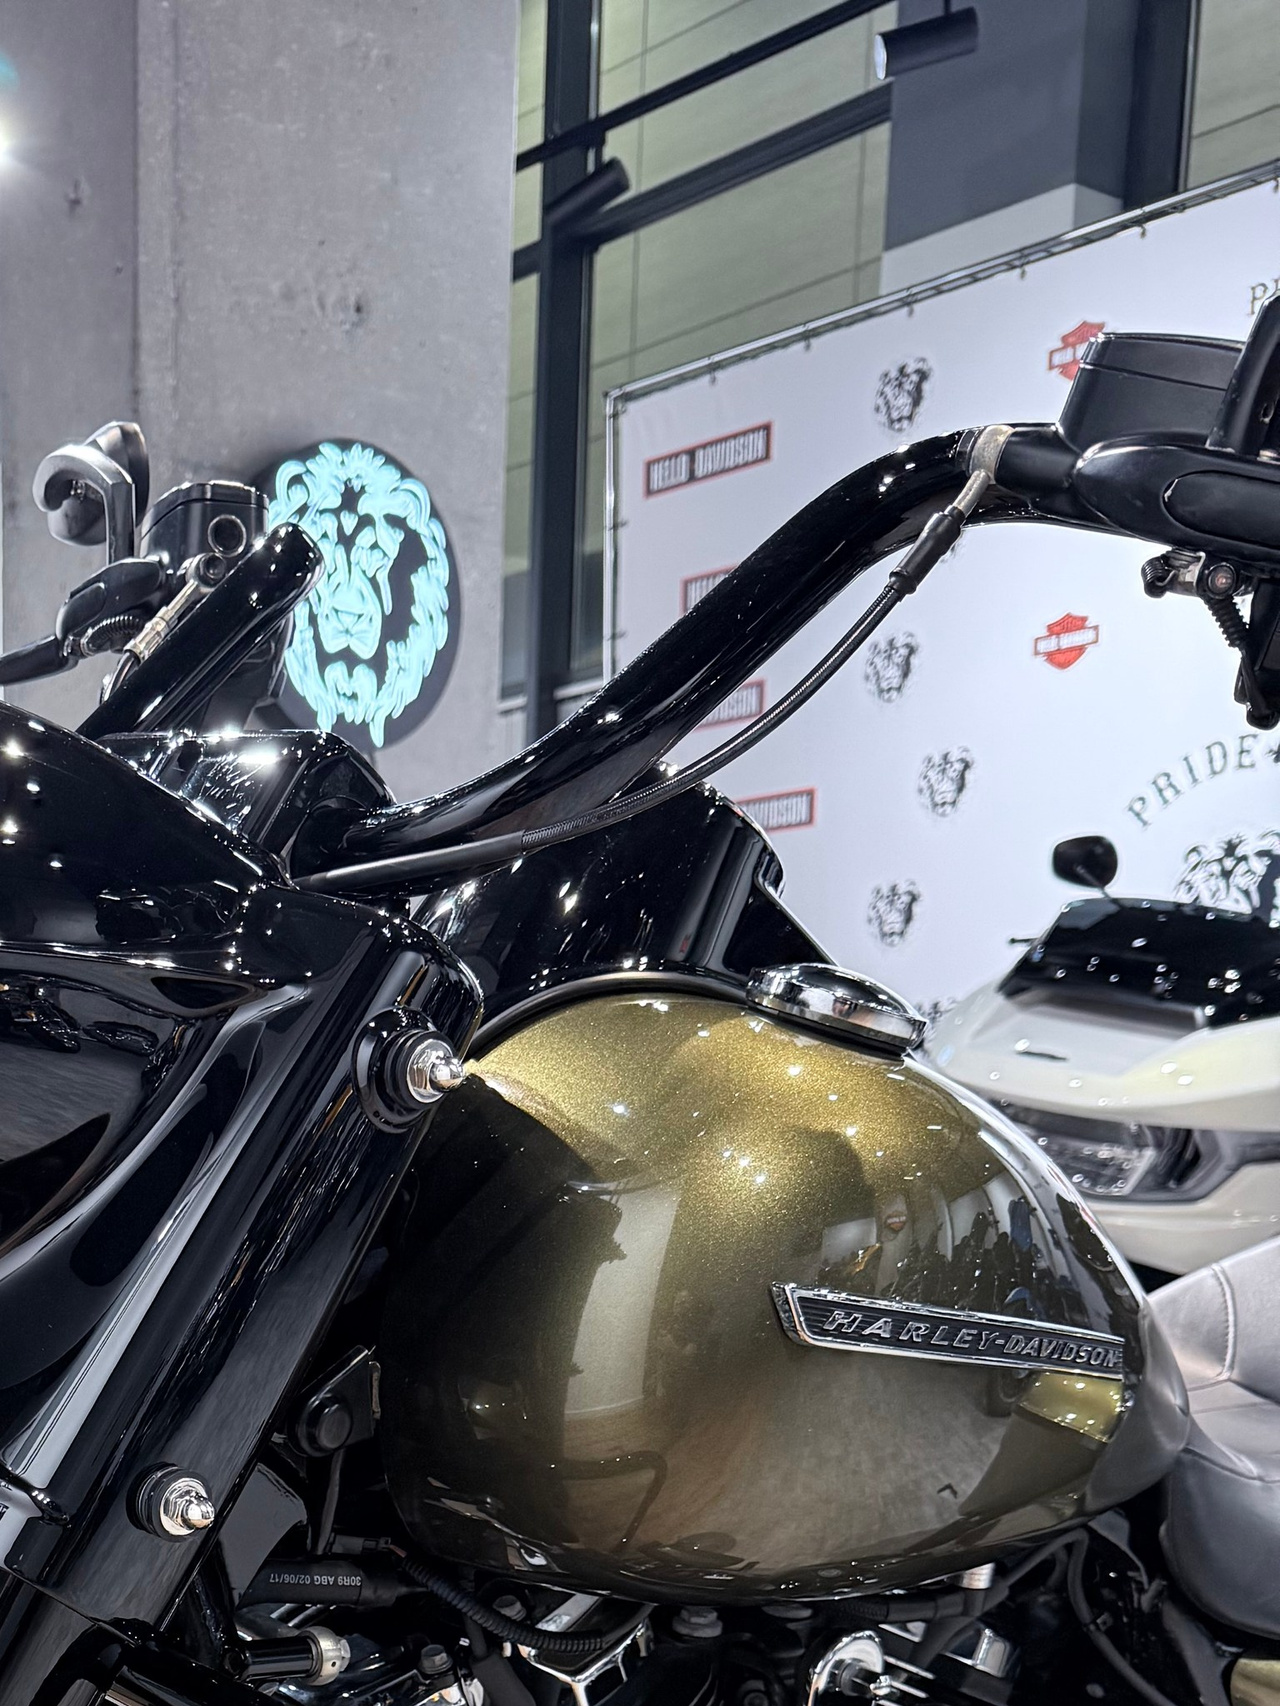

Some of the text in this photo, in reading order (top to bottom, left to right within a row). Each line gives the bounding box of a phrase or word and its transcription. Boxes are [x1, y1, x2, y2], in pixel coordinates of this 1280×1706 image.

[1127, 734, 1258, 829] PRIDE
[822, 1310, 1120, 1369] HARLEY-DAVIDSON
[269, 1573, 362, 1586] 30R9 ABG 02/06/17
